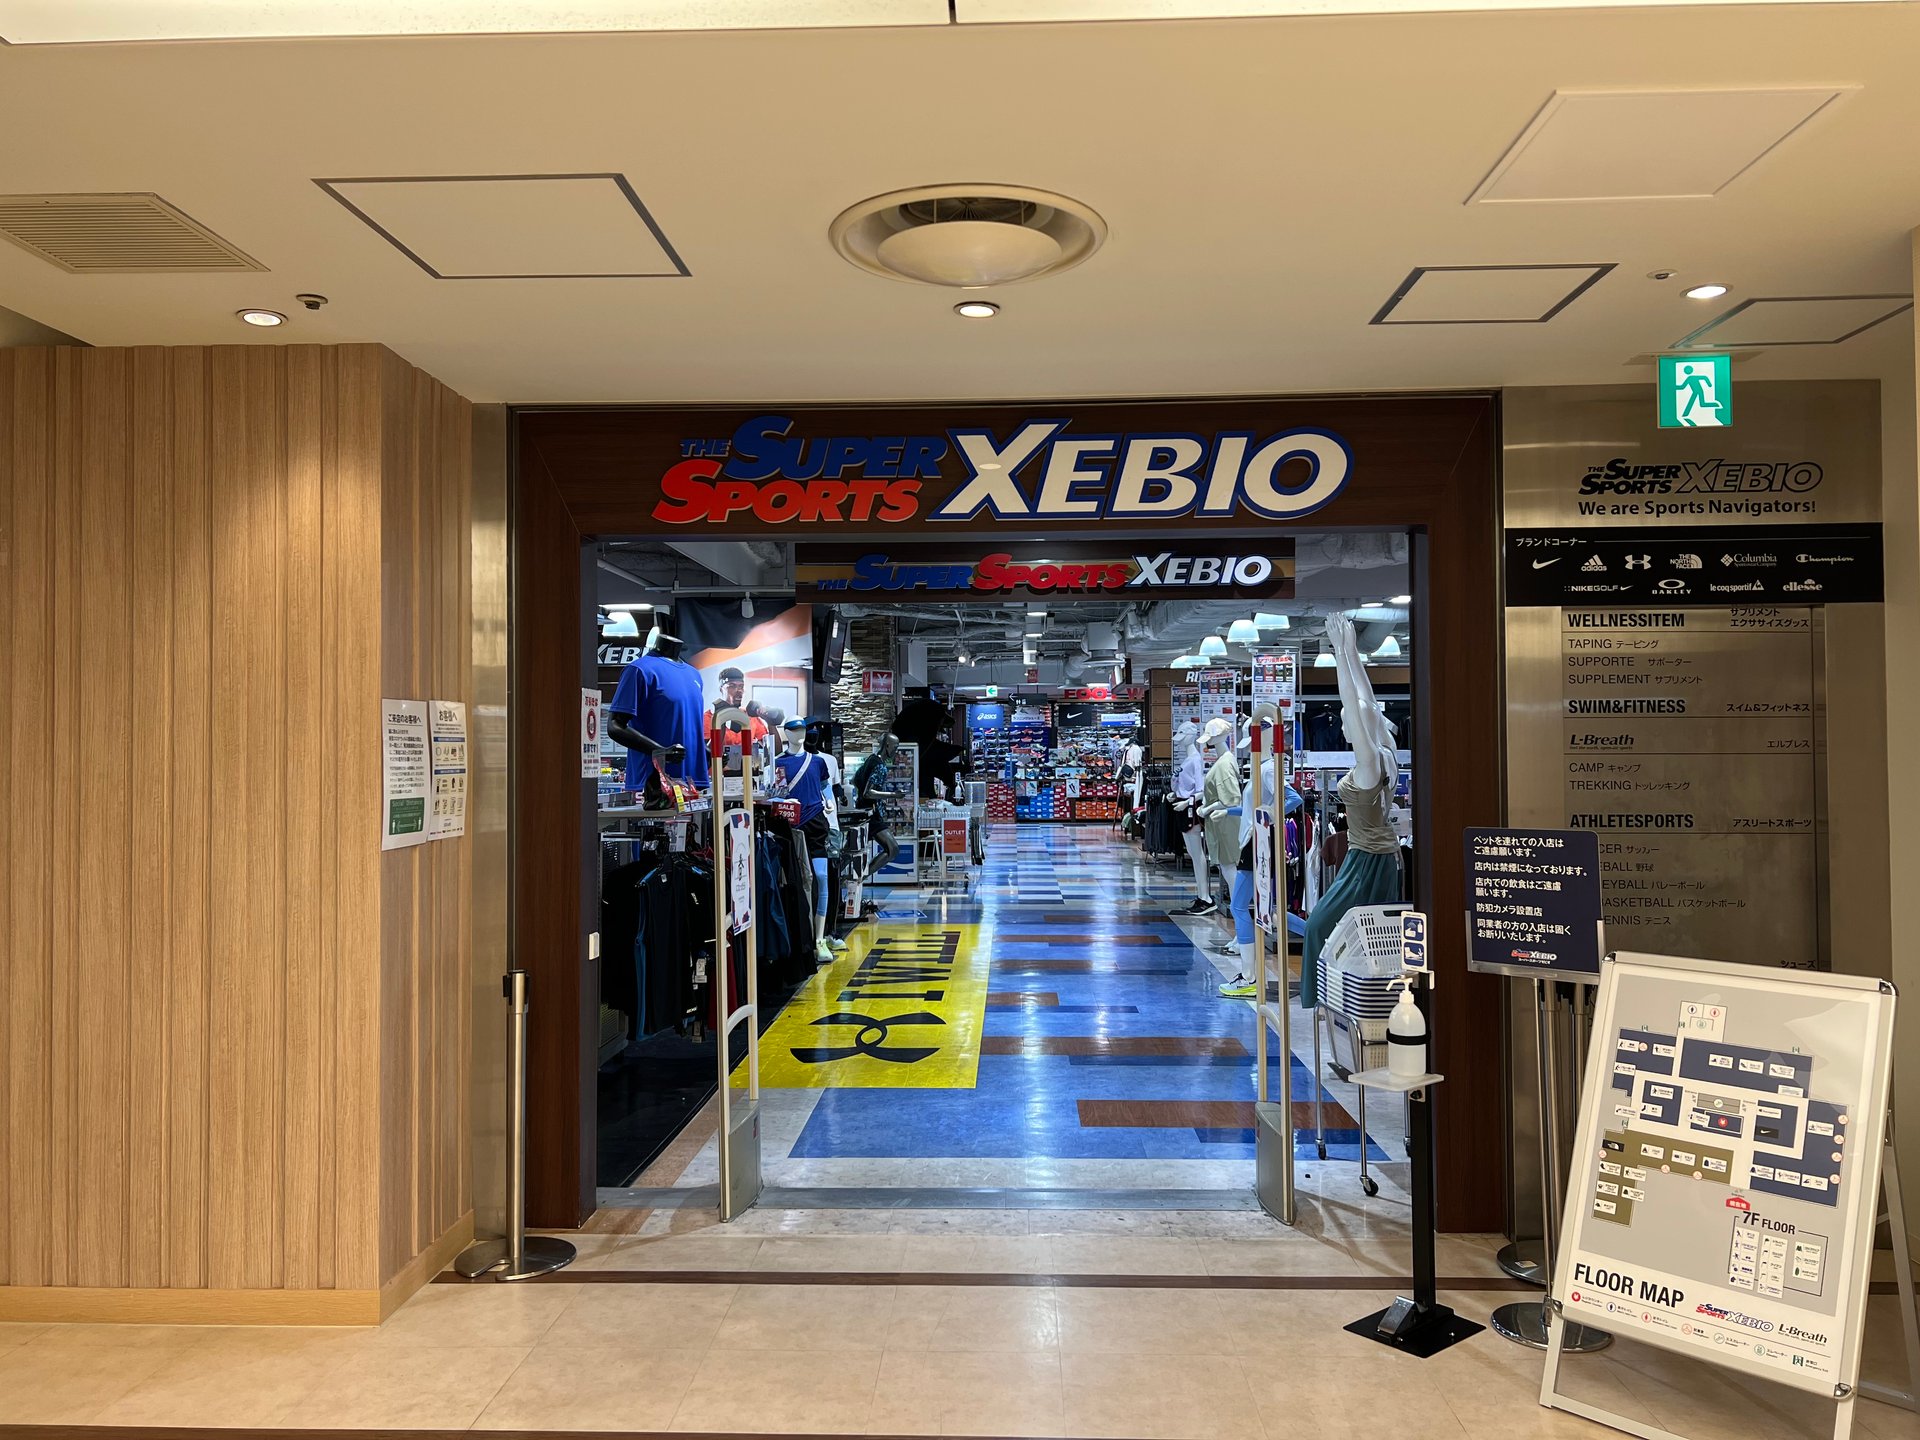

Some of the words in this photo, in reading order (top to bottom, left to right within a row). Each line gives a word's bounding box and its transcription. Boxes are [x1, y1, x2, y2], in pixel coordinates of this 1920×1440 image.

[680, 439, 731, 457] THE
[723, 416, 948, 481] SUPER
[927, 418, 1353, 522] XEBIO
[1603, 458, 1681, 479] SUPER
[1675, 459, 1823, 494] XEBIO
[1578, 473, 1672, 495] SPORTS
[651, 459, 923, 523] SPORTS
[1578, 502, 1606, 515] We
[1611, 504, 1639, 515] are
[1644, 500, 1705, 517] Sports
[1708, 499, 1816, 517] Navigators!
[1515, 538, 1588, 547] ブランドコーナー
[1733, 553, 1777, 562] Columbia
[1796, 554, 1854, 565] Champion
[850, 554, 974, 591] SUPER
[973, 553, 1129, 592] SPORTS
[1125, 551, 1273, 588] XEBIO
[1783, 581, 1823, 591] ellesse
[1568, 613, 1685, 627] WELLNESSITEM
[1730, 618, 1809, 627] エクササイズグッズ
[1568, 639, 1612, 649] TAPING
[1616, 640, 1659, 649] テーピング
[1568, 656, 1635, 667] SUPPORTE
[1568, 674, 1651, 685] SUPPLEMENT
[1568, 699, 1686, 714] SWIM&FITNESS
[1570, 734, 1634, 745] L-Breath
[1569, 763, 1604, 773] CAMP
[1569, 781, 1632, 791] TREKKING
[1570, 814, 1694, 828] ATHLETESPORTS
[1732, 818, 1812, 828] アスリートスポーツ
[1473, 836, 1564, 848] ペットを連れての入店は
[1599, 844, 1622, 854] CER
[1626, 845, 1660, 854] サッカー
[1474, 862, 1587, 877] 店内は禁煙になっております。
[1635, 863, 1654, 872] 野球
[1475, 877, 1561, 891] 店内での飲食はご遠慮
[1602, 880, 1648, 890] EYBALL
[1476, 903, 1542, 916] 防犯カメラ設置店
[1477, 918, 1571, 935] 同業者の方の入店は固く
[1604, 915, 1641, 925] ENNIS
[1644, 916, 1671, 925] テニス
[1477, 929, 1546, 944] お断りいたします。
[1530, 951, 1557, 960] XEBIO
[1743, 1211, 1760, 1226] 7F
[1761, 1219, 1795, 1234] FLOOR
[1574, 1263, 1634, 1296] FLOOR
[1639, 1281, 1684, 1308] MAP
[1705, 1304, 1729, 1316] SUPER
[1726, 1311, 1774, 1332] XEBIO
[1779, 1323, 1827, 1344] L-Breath
